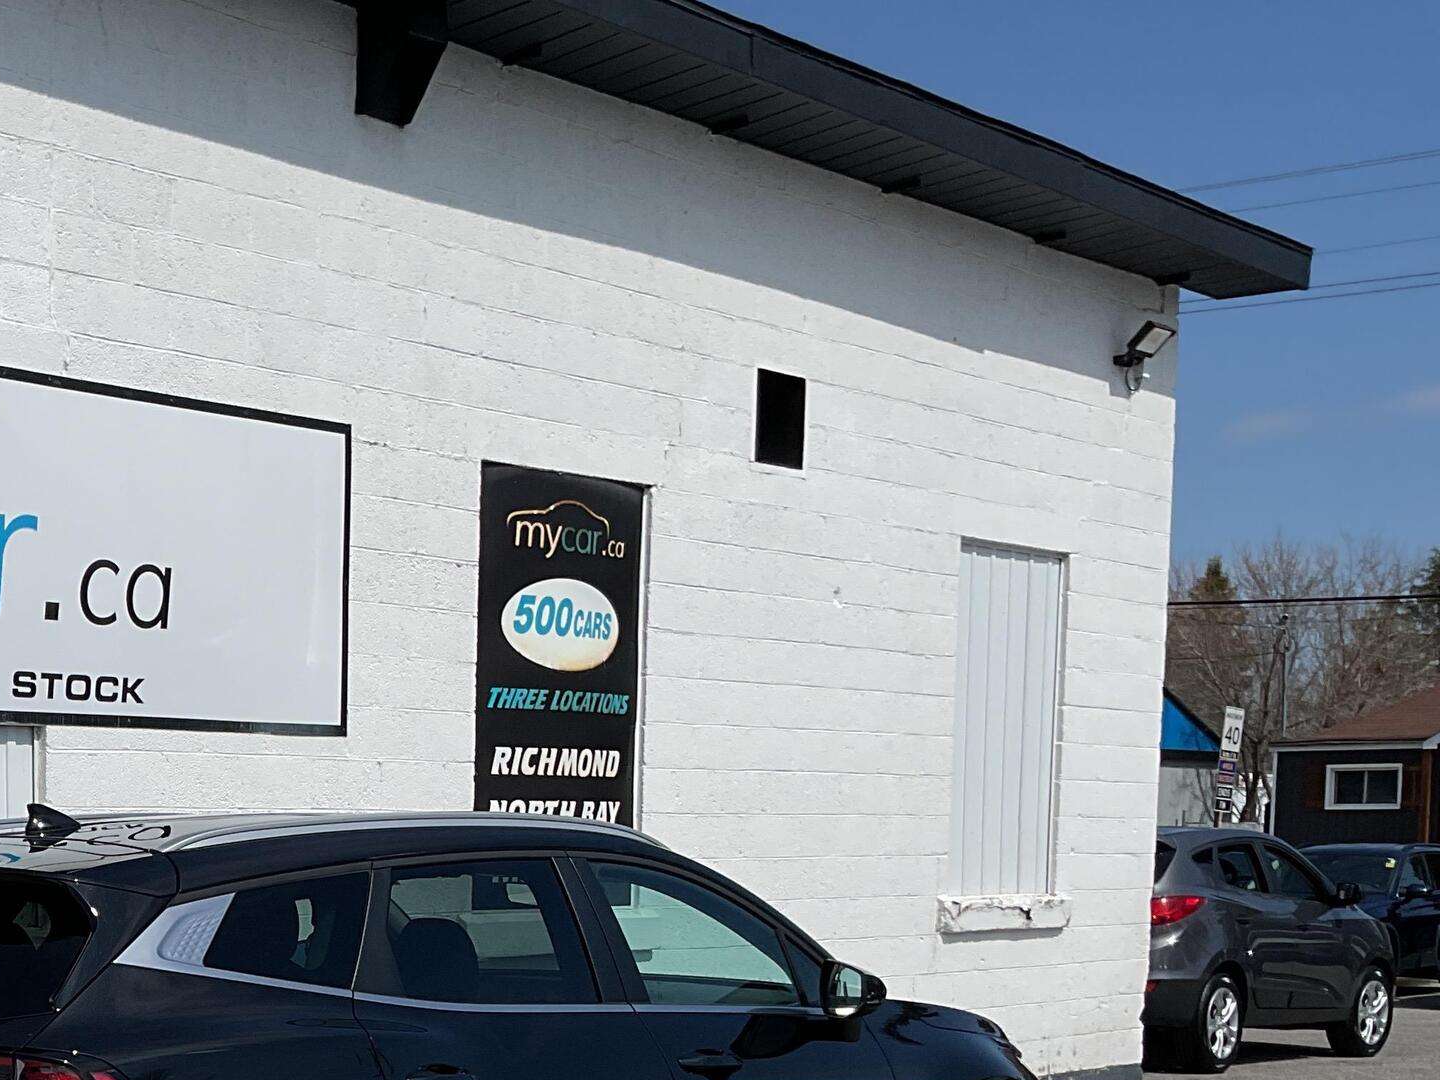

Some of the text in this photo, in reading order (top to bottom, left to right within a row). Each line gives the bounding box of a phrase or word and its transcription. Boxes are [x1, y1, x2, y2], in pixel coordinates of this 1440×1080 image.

[513, 518, 625, 559] mycar.ca
[12, 671, 146, 705] STOCK
[486, 685, 629, 715] THREE LOCATIONS
[1225, 726, 1240, 745] 40
[490, 746, 621, 779] RICHMOND
[581, 800, 621, 824] BAY
